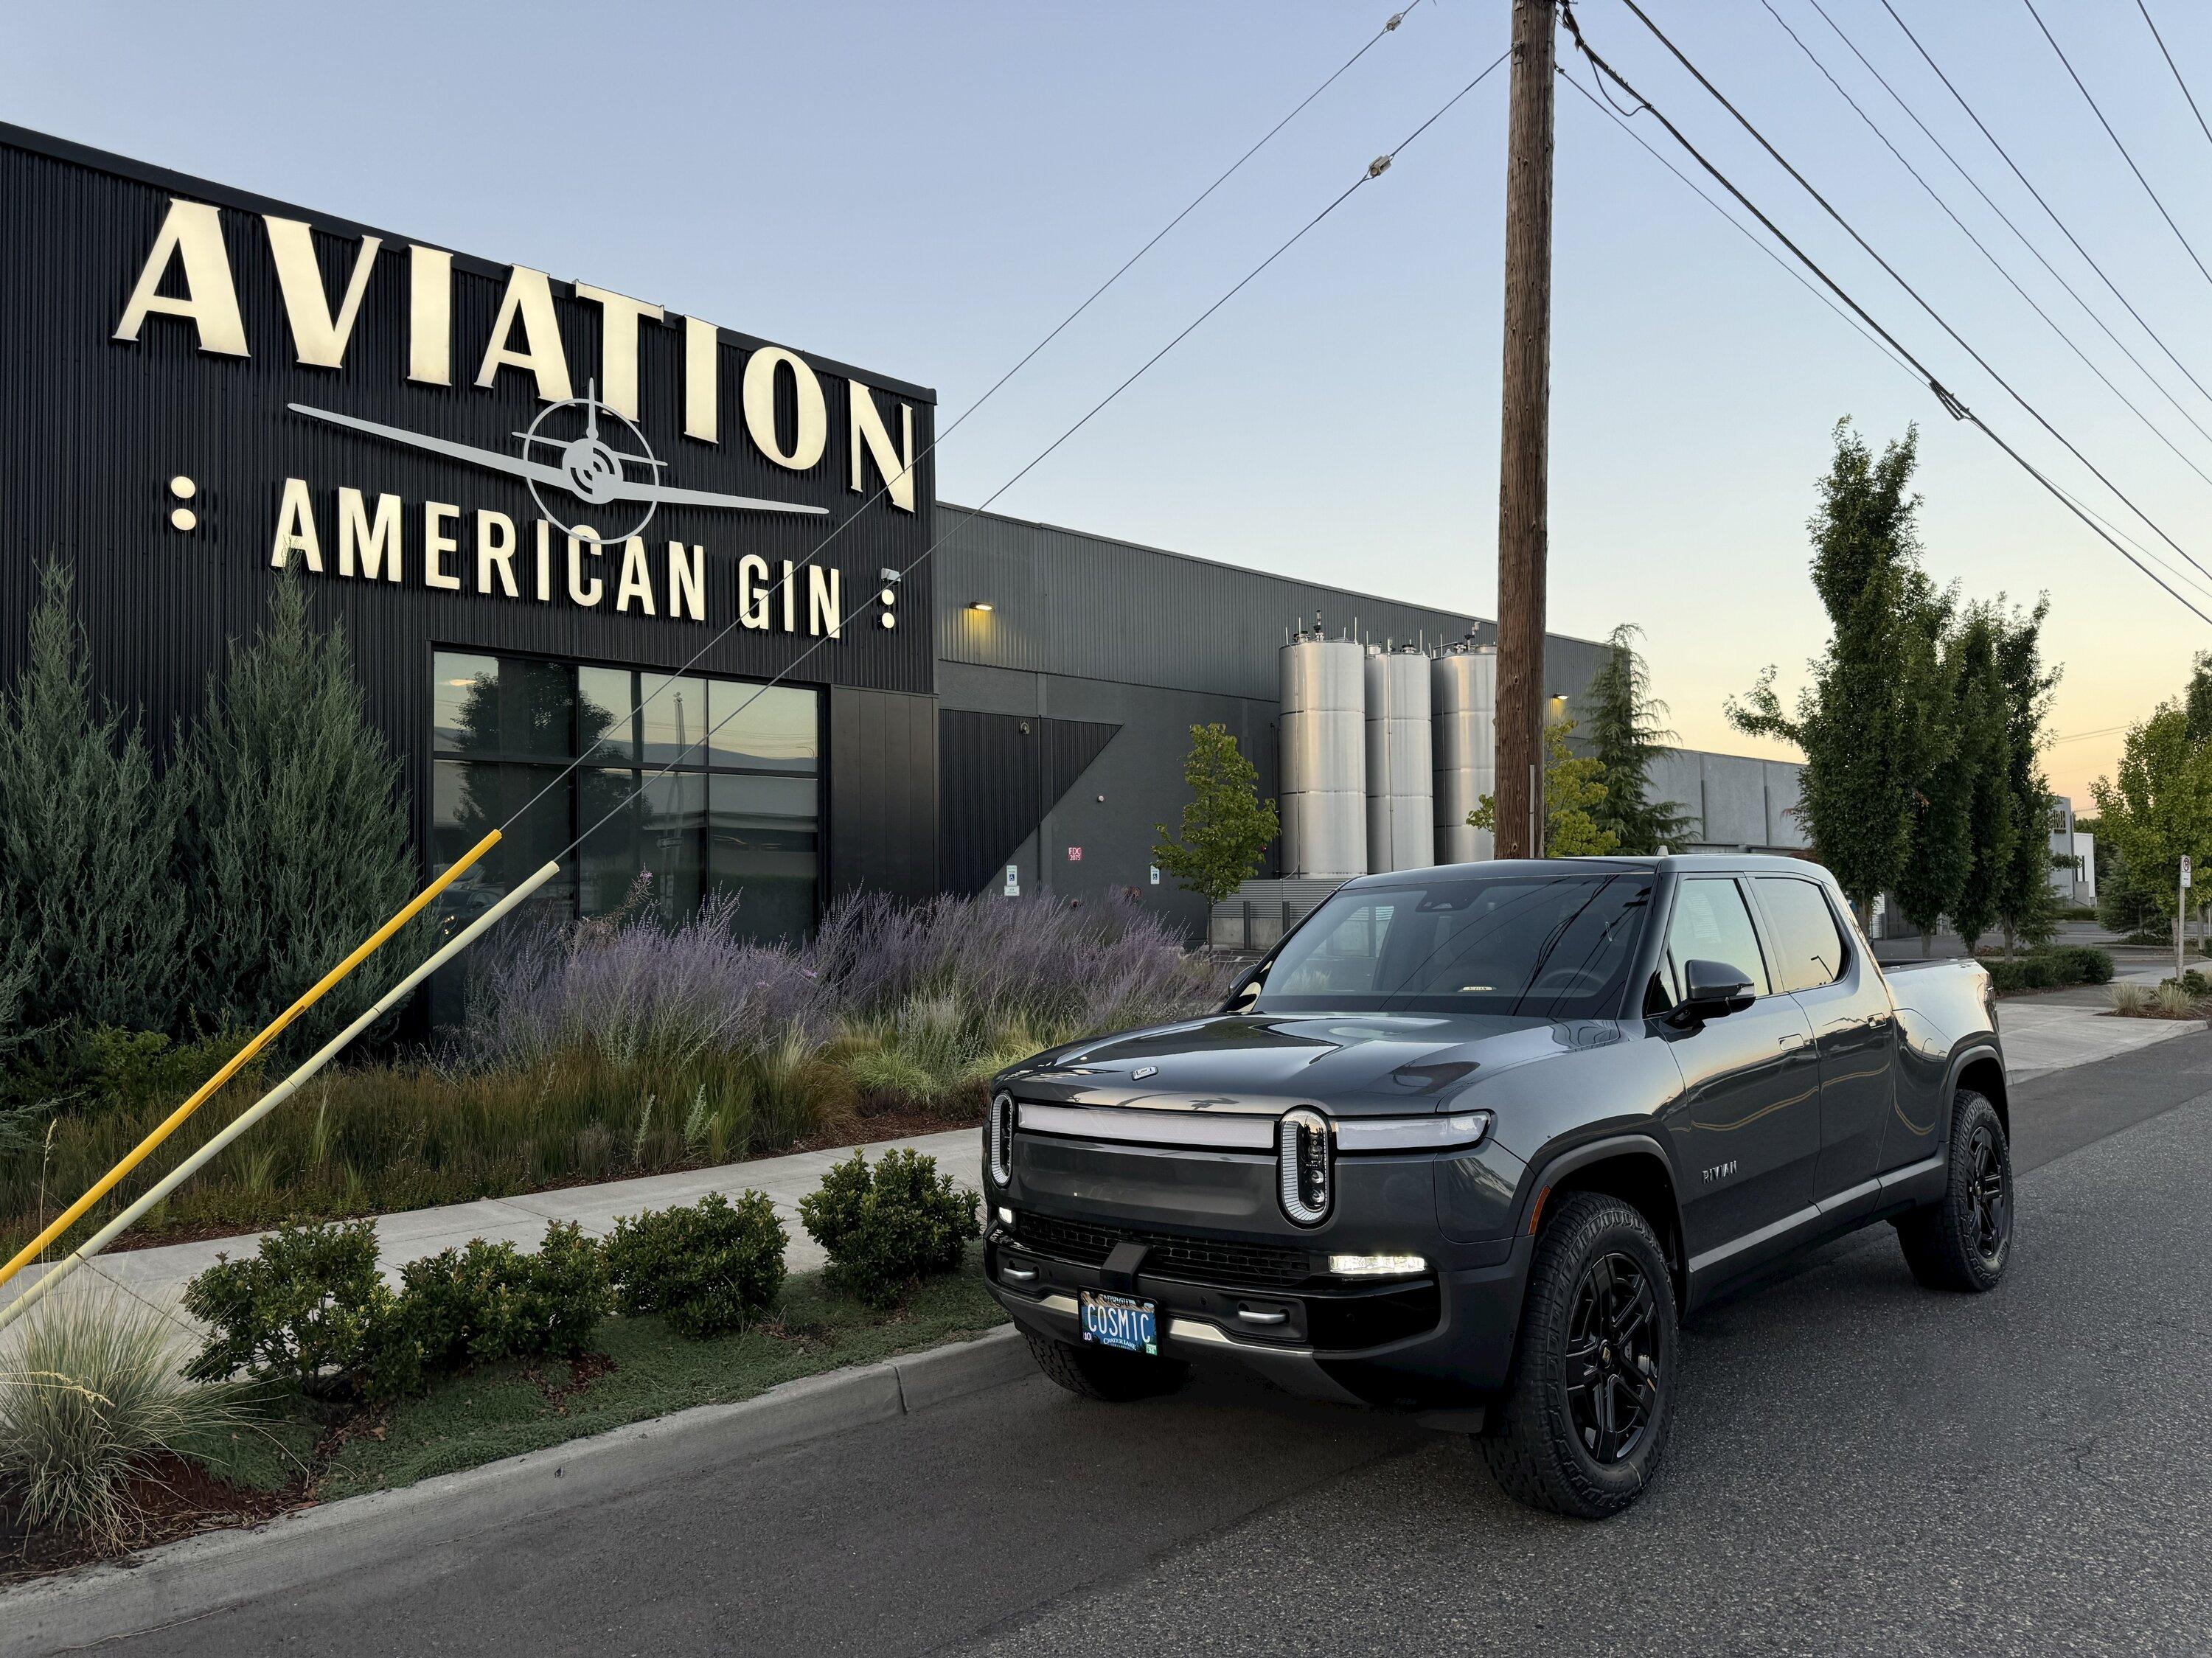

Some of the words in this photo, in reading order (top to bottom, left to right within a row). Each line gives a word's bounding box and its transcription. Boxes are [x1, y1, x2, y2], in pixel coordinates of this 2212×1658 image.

[112, 198, 915, 512] AVIATION
[271, 478, 705, 621] AMERICAN
[739, 554, 841, 638] GIN
[1068, 847, 1081, 855] FDC
